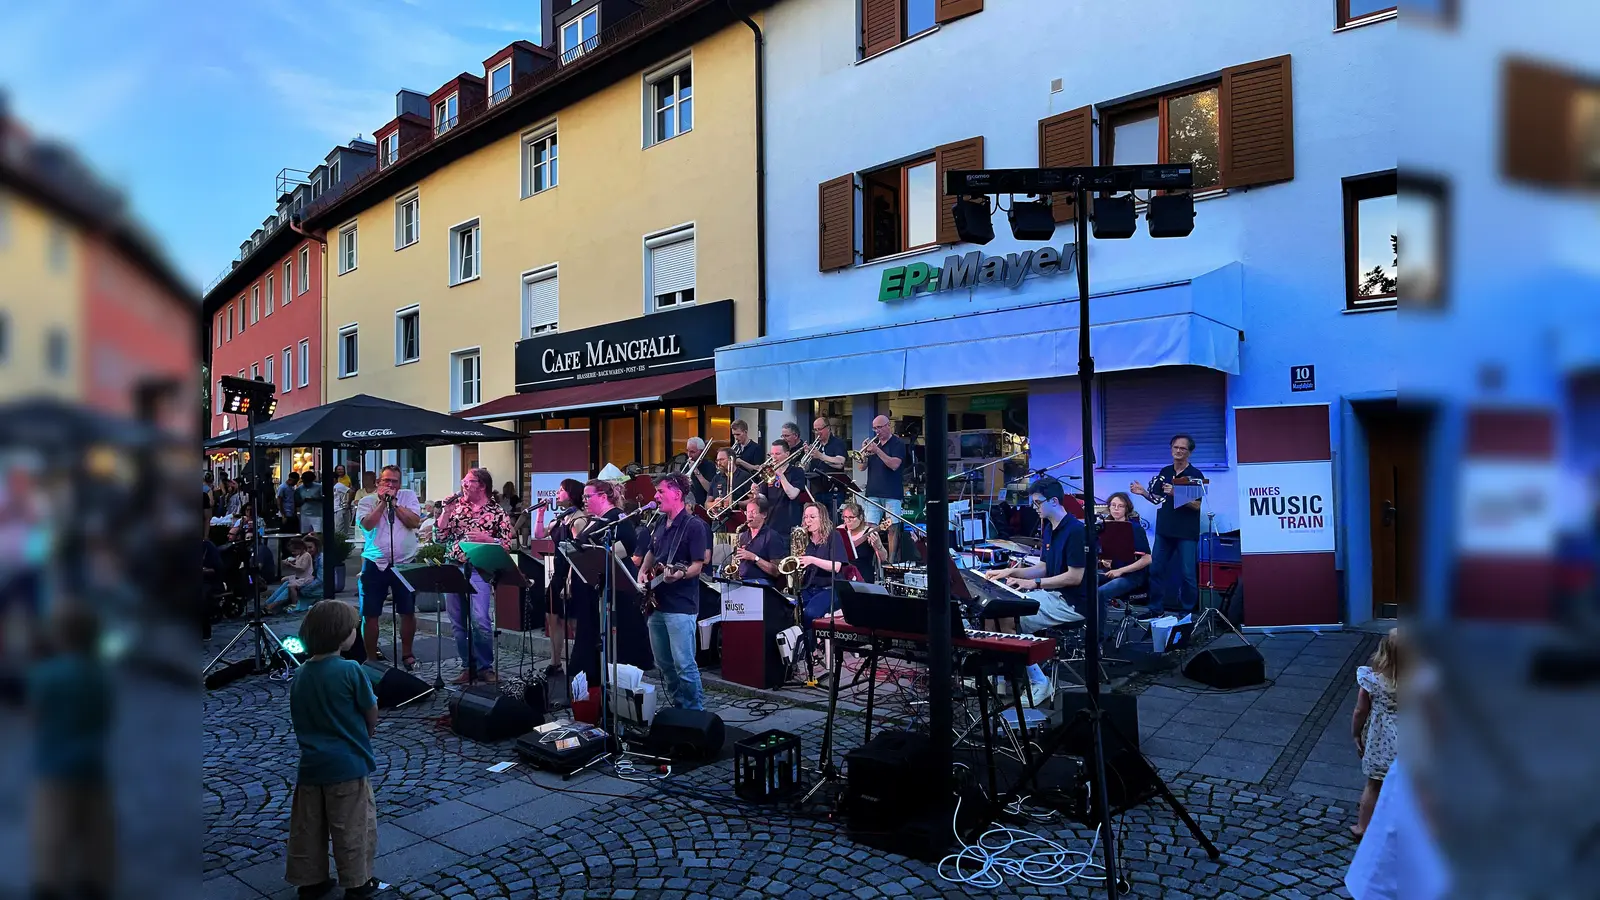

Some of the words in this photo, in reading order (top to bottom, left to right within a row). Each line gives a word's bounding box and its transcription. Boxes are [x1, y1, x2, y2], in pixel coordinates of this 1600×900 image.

[541, 349, 581, 373] CAFE
[586, 334, 680, 367] MANGFALL
[1295, 367, 1310, 380] 10
[342, 428, 397, 438] Coca-Cola
[1249, 486, 1280, 497] MIKES
[1249, 495, 1323, 516] MUSIC
[1278, 515, 1324, 529] TRAIN
